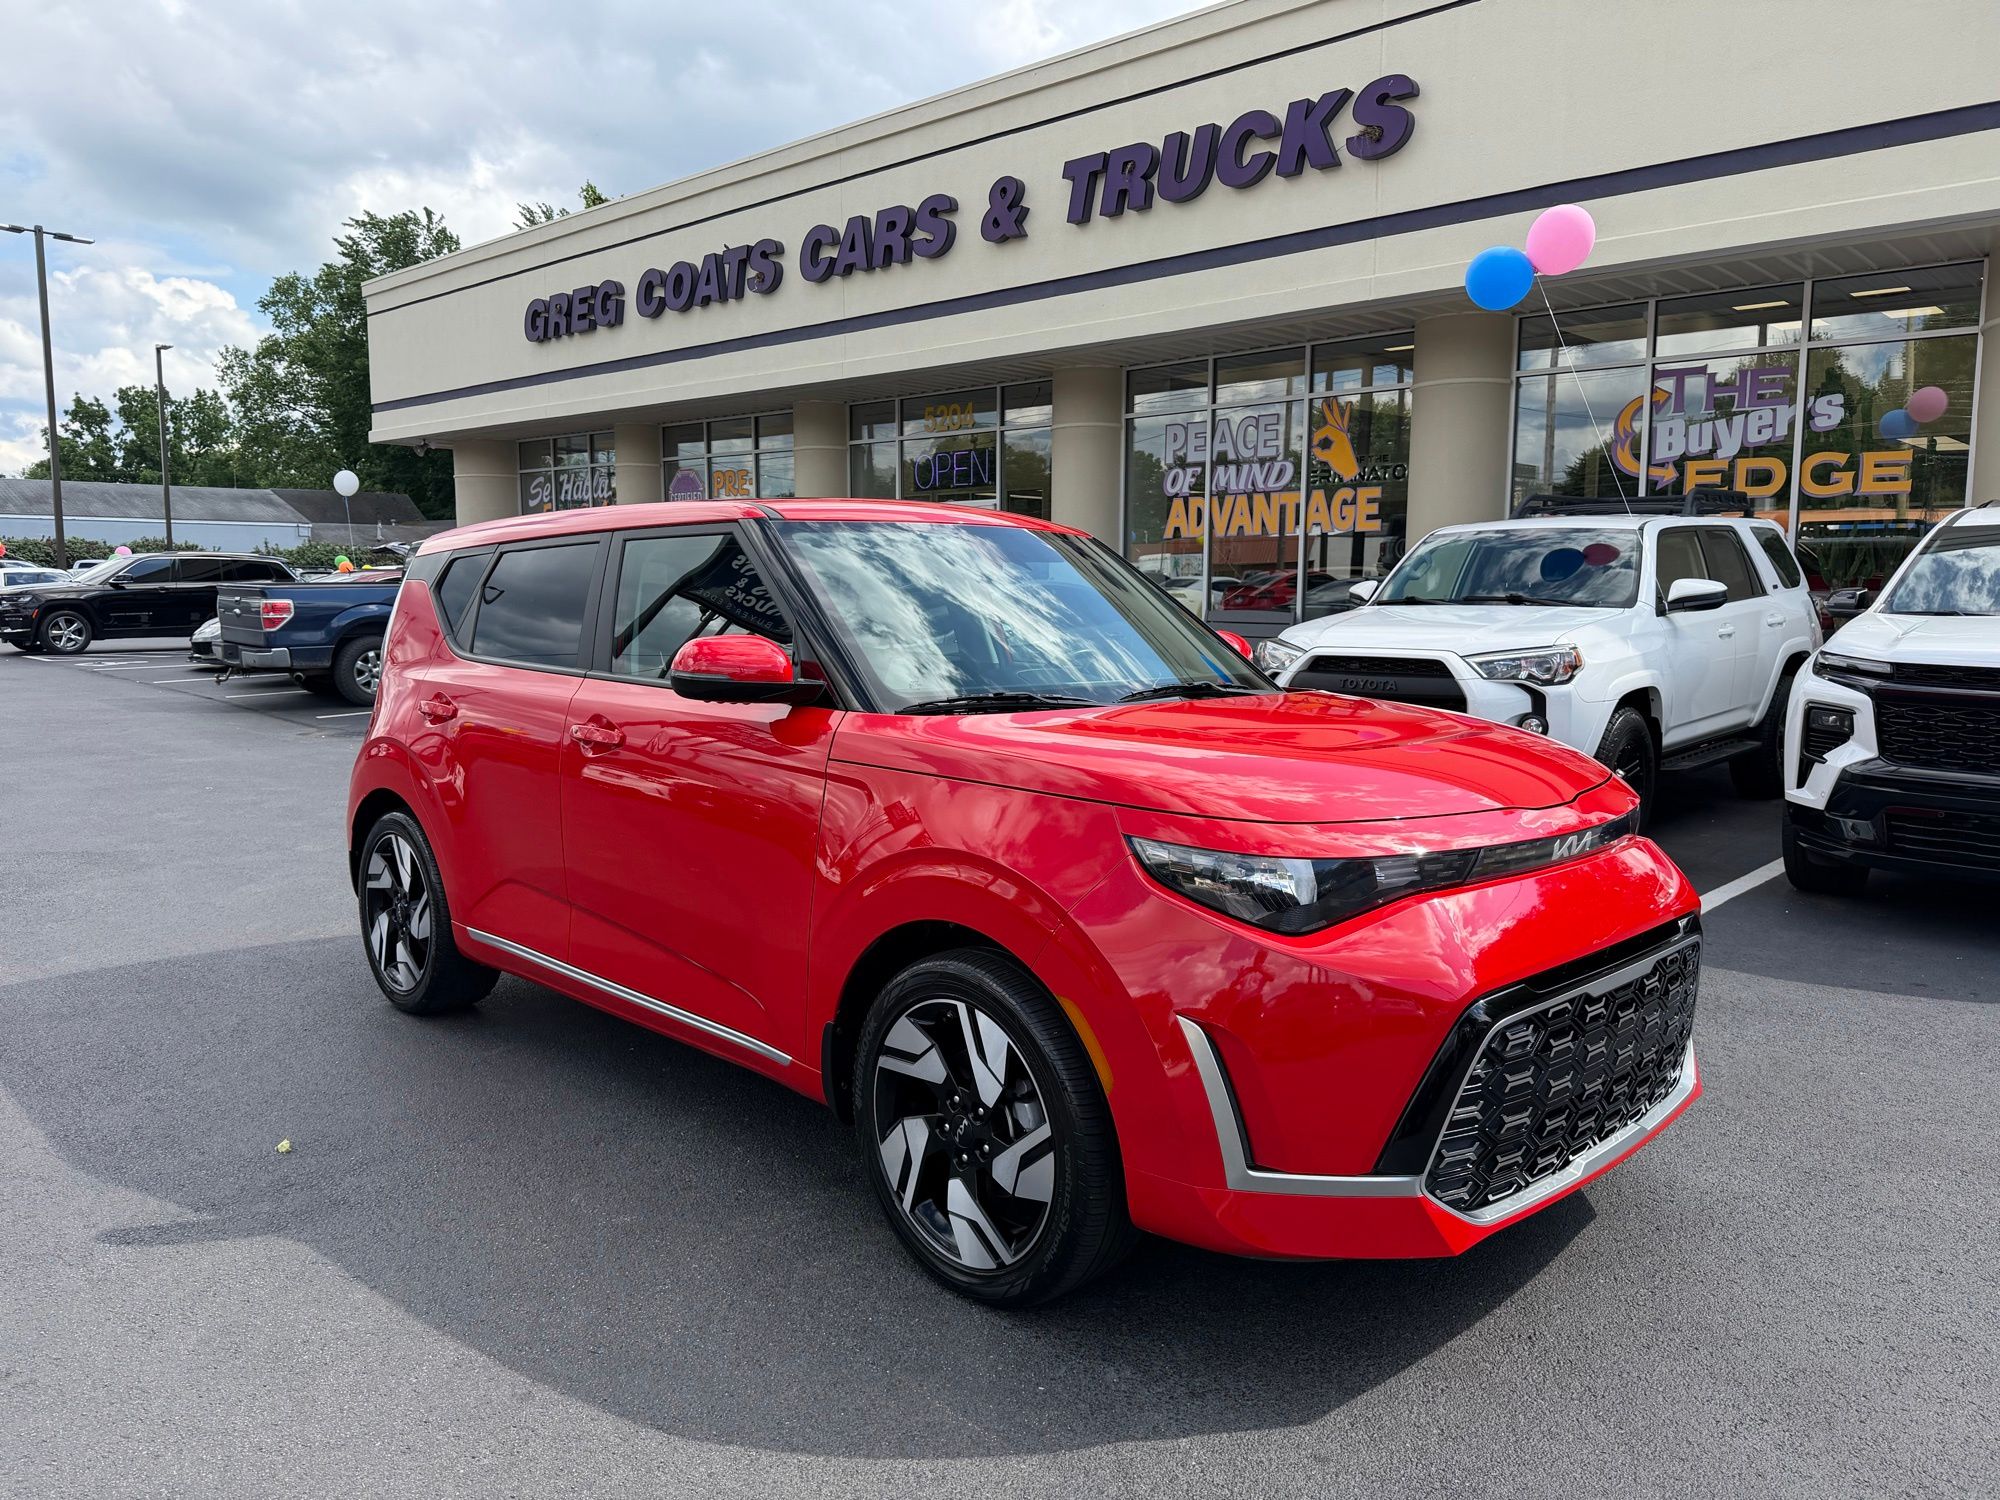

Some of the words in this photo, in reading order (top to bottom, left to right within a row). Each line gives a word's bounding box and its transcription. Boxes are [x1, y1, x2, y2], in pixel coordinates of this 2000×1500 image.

[524, 279, 625, 343] GREG
[636, 238, 784, 319] COATS
[800, 193, 958, 283] CARS
[981, 175, 1030, 243] &
[1062, 73, 1420, 226] TRUCKS
[1654, 364, 1793, 418] THE
[924, 402, 976, 433] 5204
[1165, 413, 1280, 464] PEACE
[1654, 392, 1844, 465] Buyer's
[528, 476, 551, 507] Se
[560, 468, 612, 502] Habla
[915, 449, 989, 489] OPEN
[1164, 467, 1202, 497] OF
[1211, 460, 1295, 495] MIND
[1683, 449, 1913, 498] EDGE
[1163, 486, 1382, 539] ADVANTAGE
[1340, 678, 1398, 691] TOYOTA
